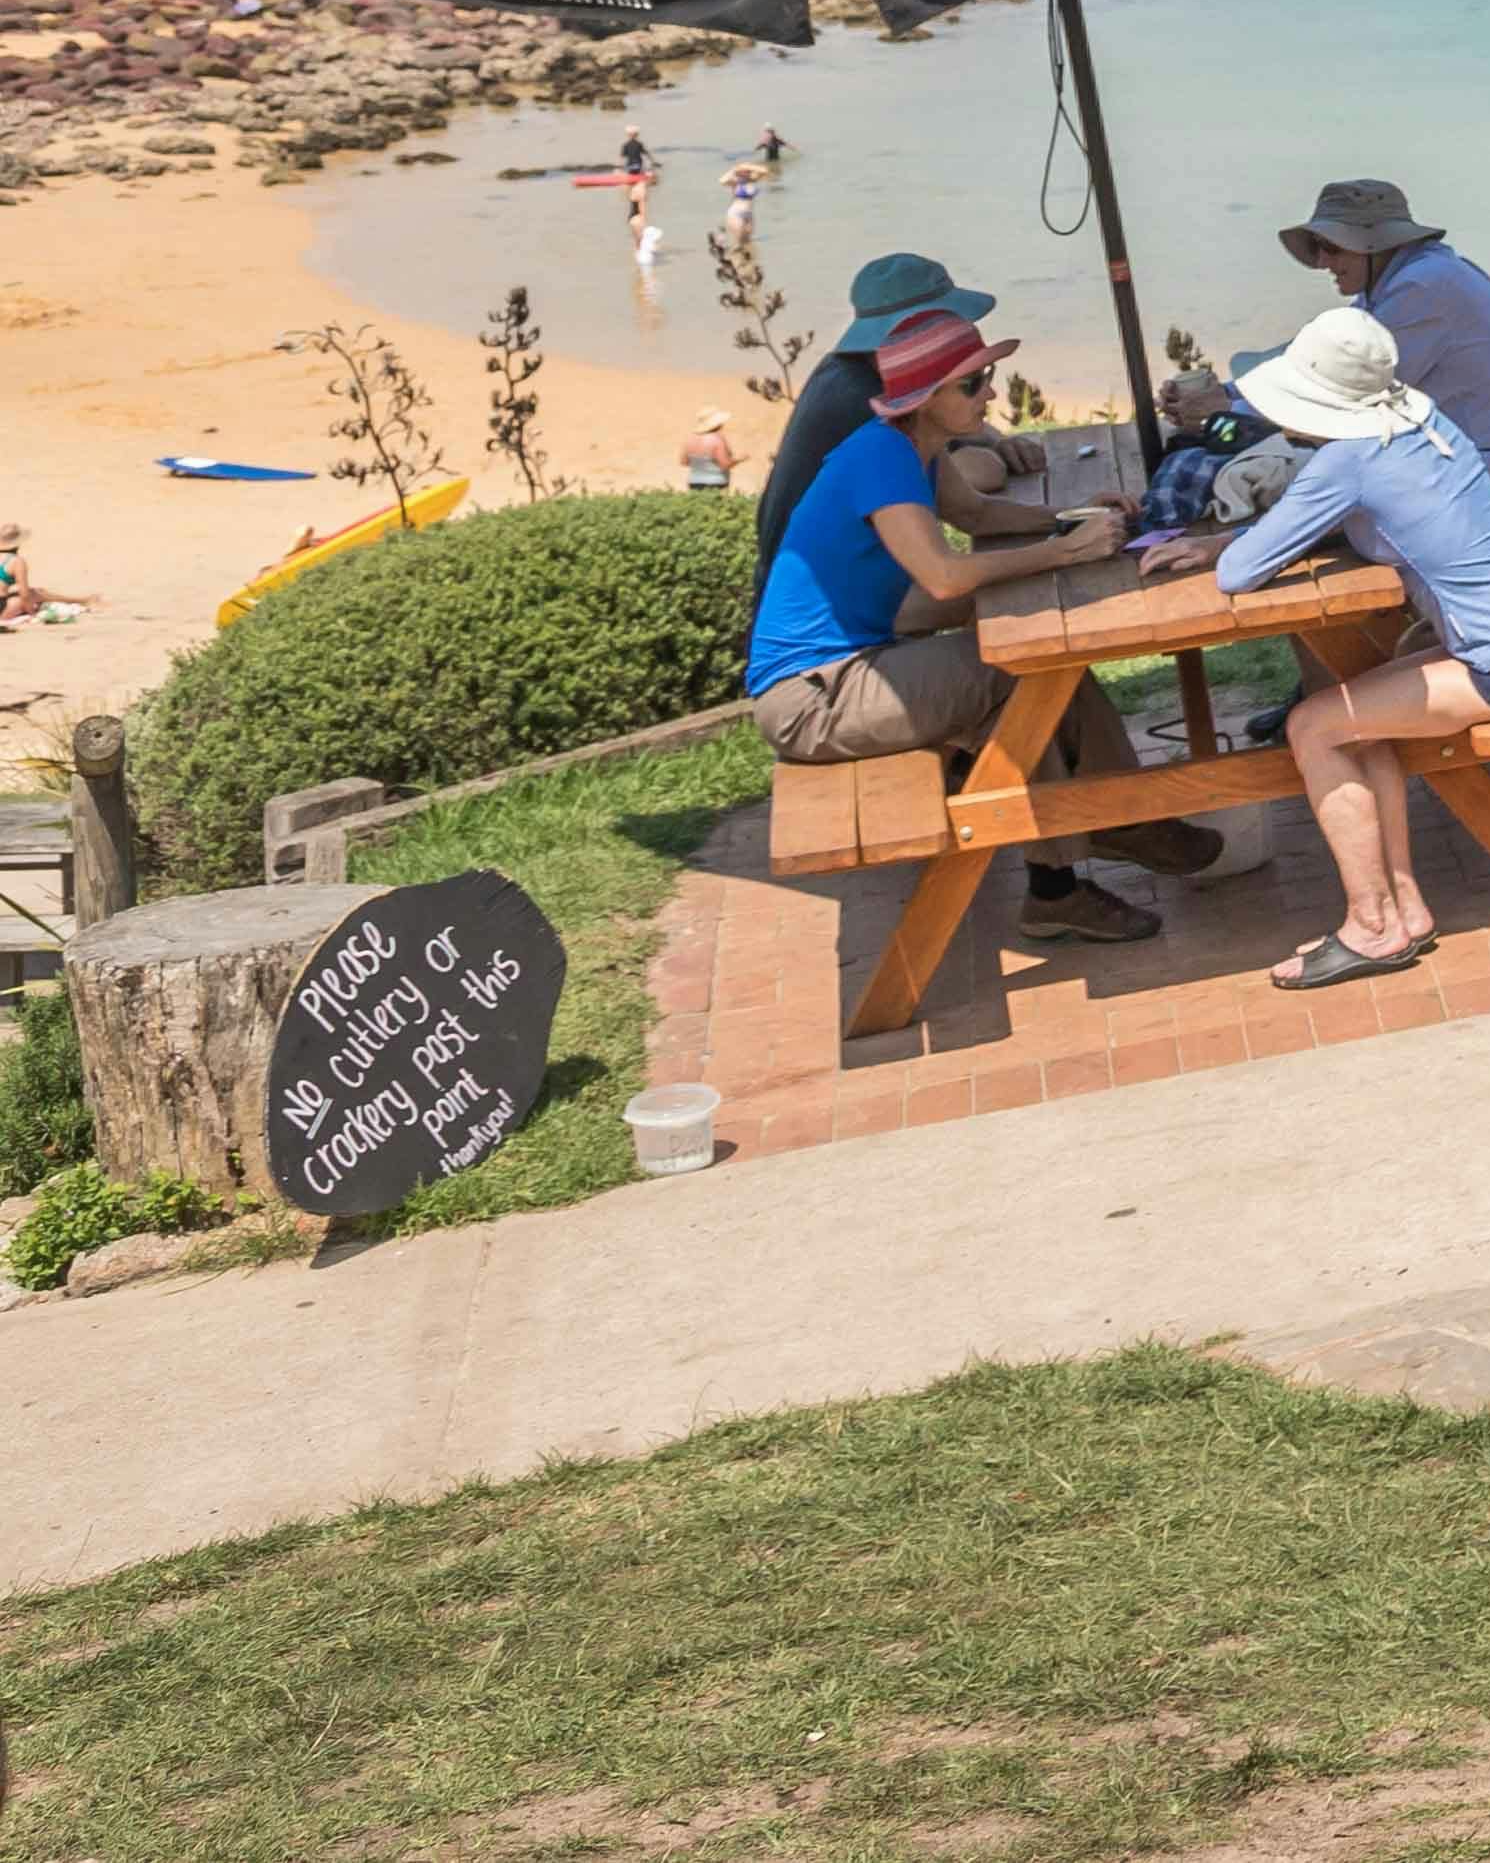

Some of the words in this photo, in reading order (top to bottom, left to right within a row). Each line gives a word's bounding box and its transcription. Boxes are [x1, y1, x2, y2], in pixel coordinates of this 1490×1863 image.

[298, 921, 397, 1034] Please
[425, 926, 461, 973] or
[411, 1007, 481, 1089] past
[459, 949, 521, 1010] this
[422, 1067, 489, 1149] point
